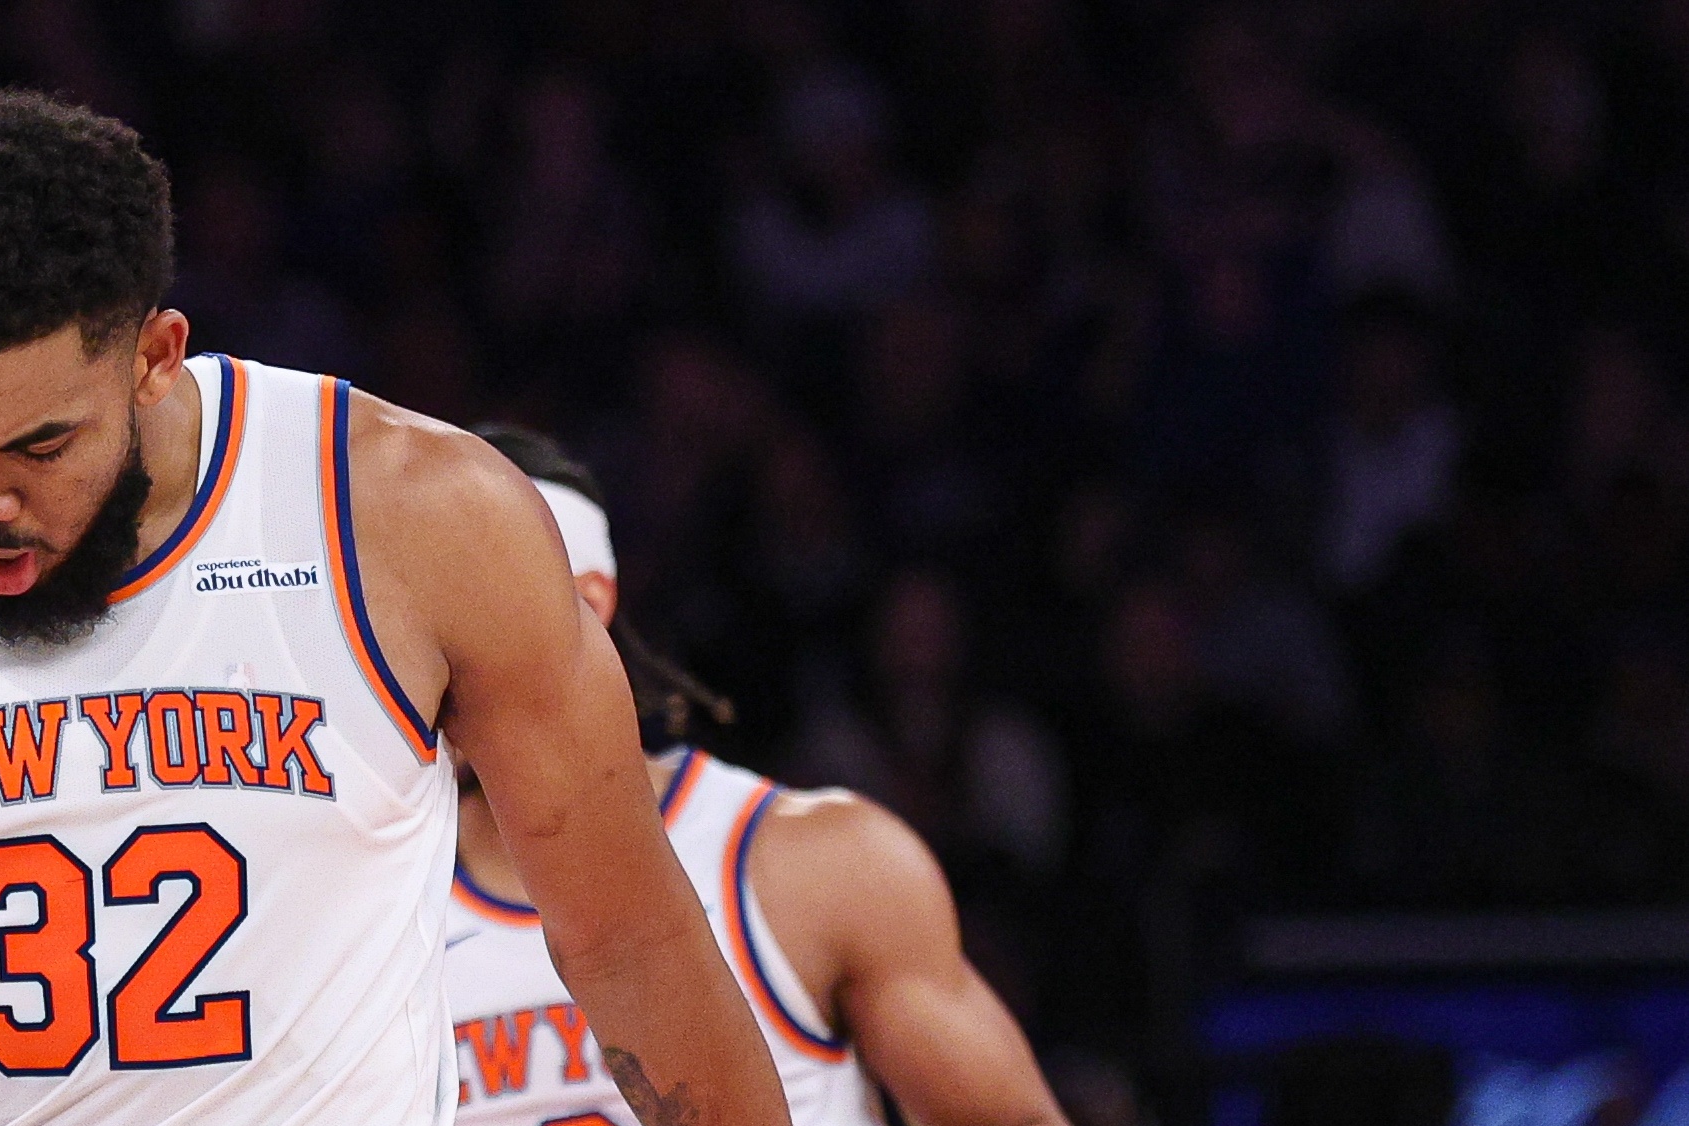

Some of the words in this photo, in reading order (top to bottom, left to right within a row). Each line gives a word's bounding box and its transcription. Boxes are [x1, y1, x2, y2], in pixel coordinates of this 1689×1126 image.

[196, 559, 261, 572] experience
[196, 572, 243, 592] abu
[75, 686, 337, 801] YORK
